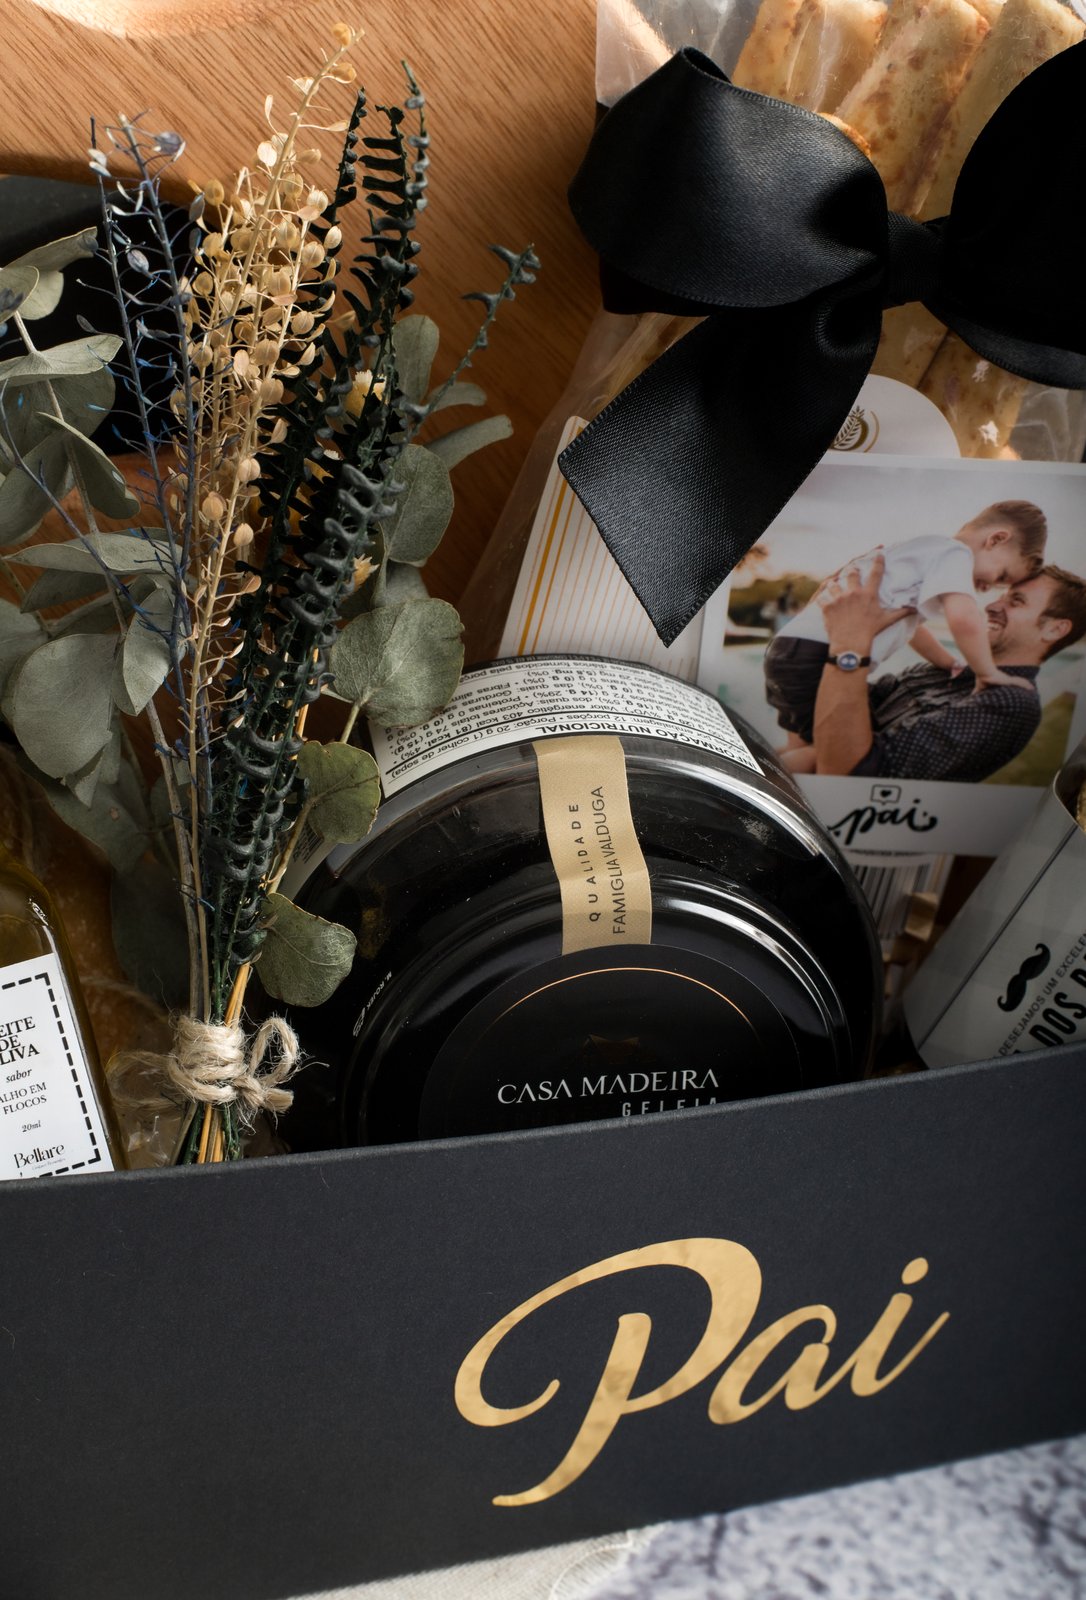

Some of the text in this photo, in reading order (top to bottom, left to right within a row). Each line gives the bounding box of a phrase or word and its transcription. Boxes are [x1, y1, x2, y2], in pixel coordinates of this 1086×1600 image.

[490, 665, 512, 674] pela
[515, 661, 570, 670] fornecidos
[523, 676, 545, 684] 0%)
[477, 682, 511, 693] Fibras
[517, 684, 549, 692] quais:
[462, 690, 512, 706] Gorduras
[533, 691, 561, 699] 29%)
[536, 697, 569, 705] quais:
[483, 701, 533, 716] Açúcares
[527, 704, 586, 714] energético
[590, 704, 618, 712] Valor
[434, 717, 443, 726] (0
[451, 713, 479, 728] totais
[476, 717, 498, 727] kcal
[502, 711, 523, 720] 403
[513, 716, 556, 727] Porção:
[436, 725, 448, 734] 74
[456, 723, 472, 734] (81
[535, 722, 650, 734] NUTRICIONAL
[396, 731, 416, 745] 0%)
[407, 736, 423, 747] (15
[438, 737, 469, 753] colher
[655, 728, 757, 770] INFORMAÇÃO
[400, 746, 421, 760] 4%)
[421, 752, 434, 760] de
[391, 759, 419, 778] sopa)
[827, 799, 938, 846] pai
[569, 804, 601, 923] QUALIDADE
[590, 786, 627, 935] FAMIGLIA VALDUGA
[998, 995, 1046, 1056] DESEJAMOS
[1043, 977, 1059, 995] UM
[1029, 992, 1086, 1047] DOS
[0, 1035, 21, 1052] DE
[0, 1043, 40, 1066] LIVA
[6, 1068, 33, 1083] sabor
[29, 1082, 47, 1095] EM
[497, 1068, 719, 1104] CASA MADEIRA
[3, 1094, 47, 1115] FLOCOS
[21, 1120, 42, 1133] 20ml
[13, 1144, 65, 1169] Bellare
[454, 1237, 951, 1507] Pai
